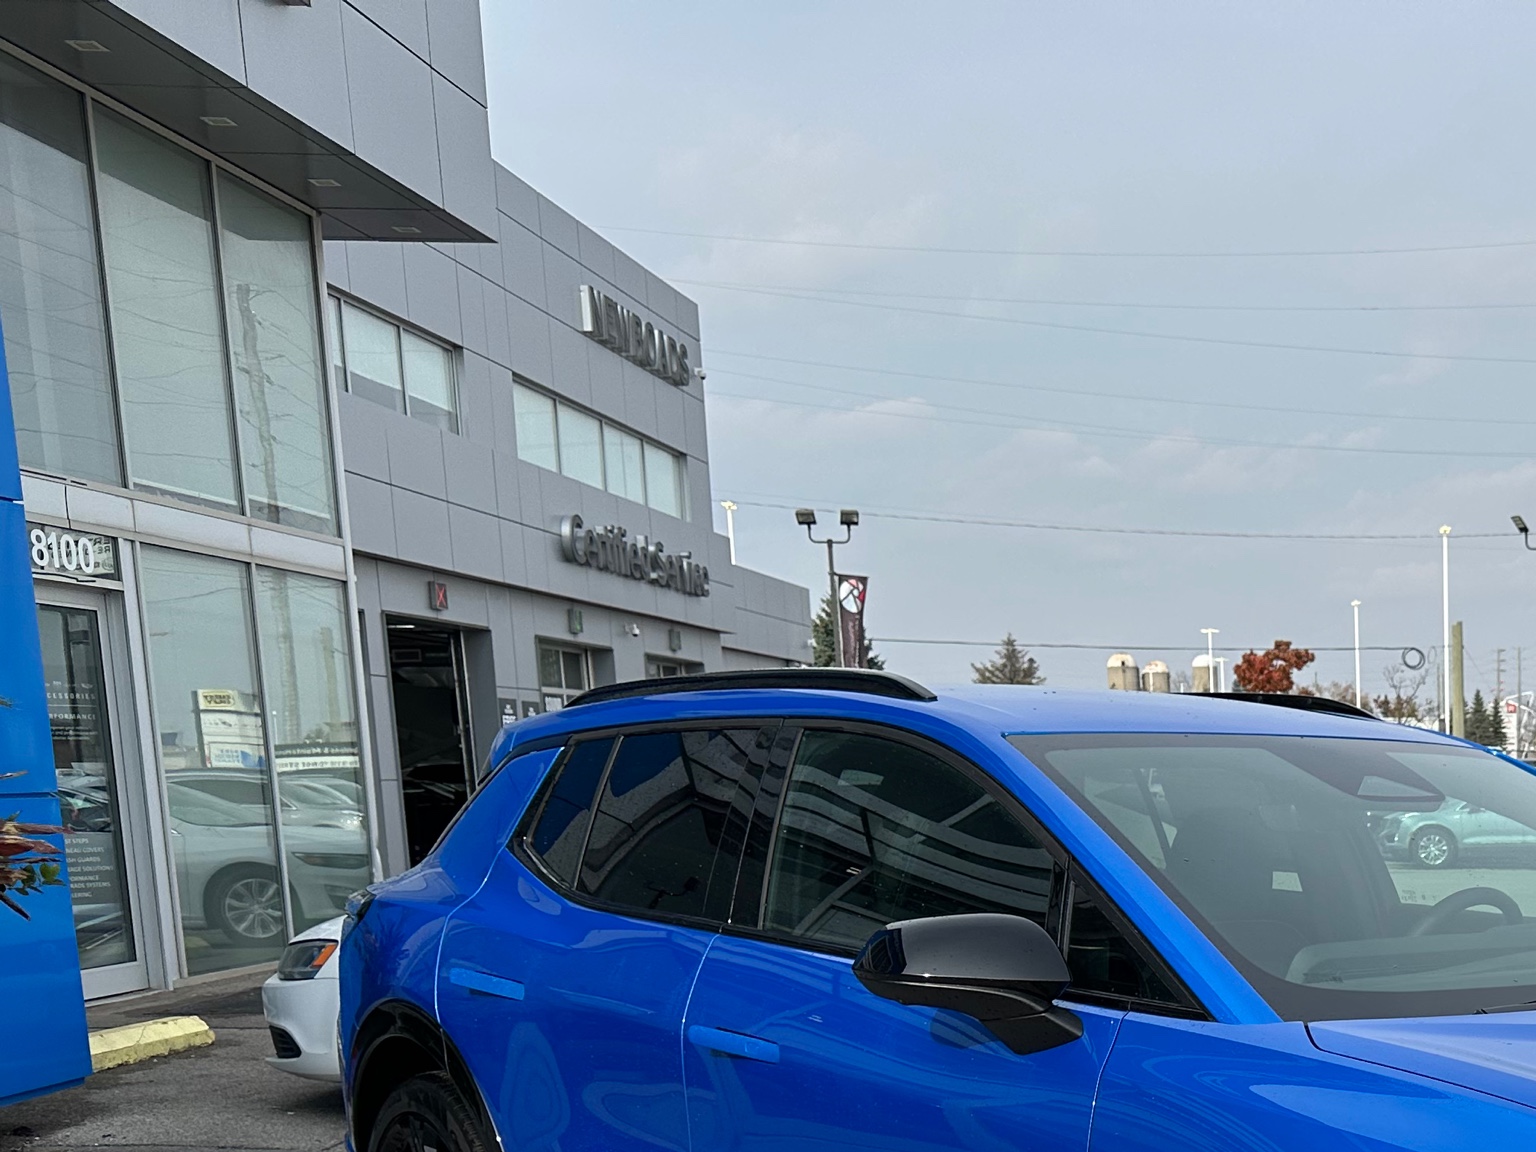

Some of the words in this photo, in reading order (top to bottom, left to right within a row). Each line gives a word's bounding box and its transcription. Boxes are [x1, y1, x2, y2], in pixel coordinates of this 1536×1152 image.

[31, 529, 95, 574] 8100
[561, 514, 651, 583] Certified
[649, 541, 709, 597] Service
